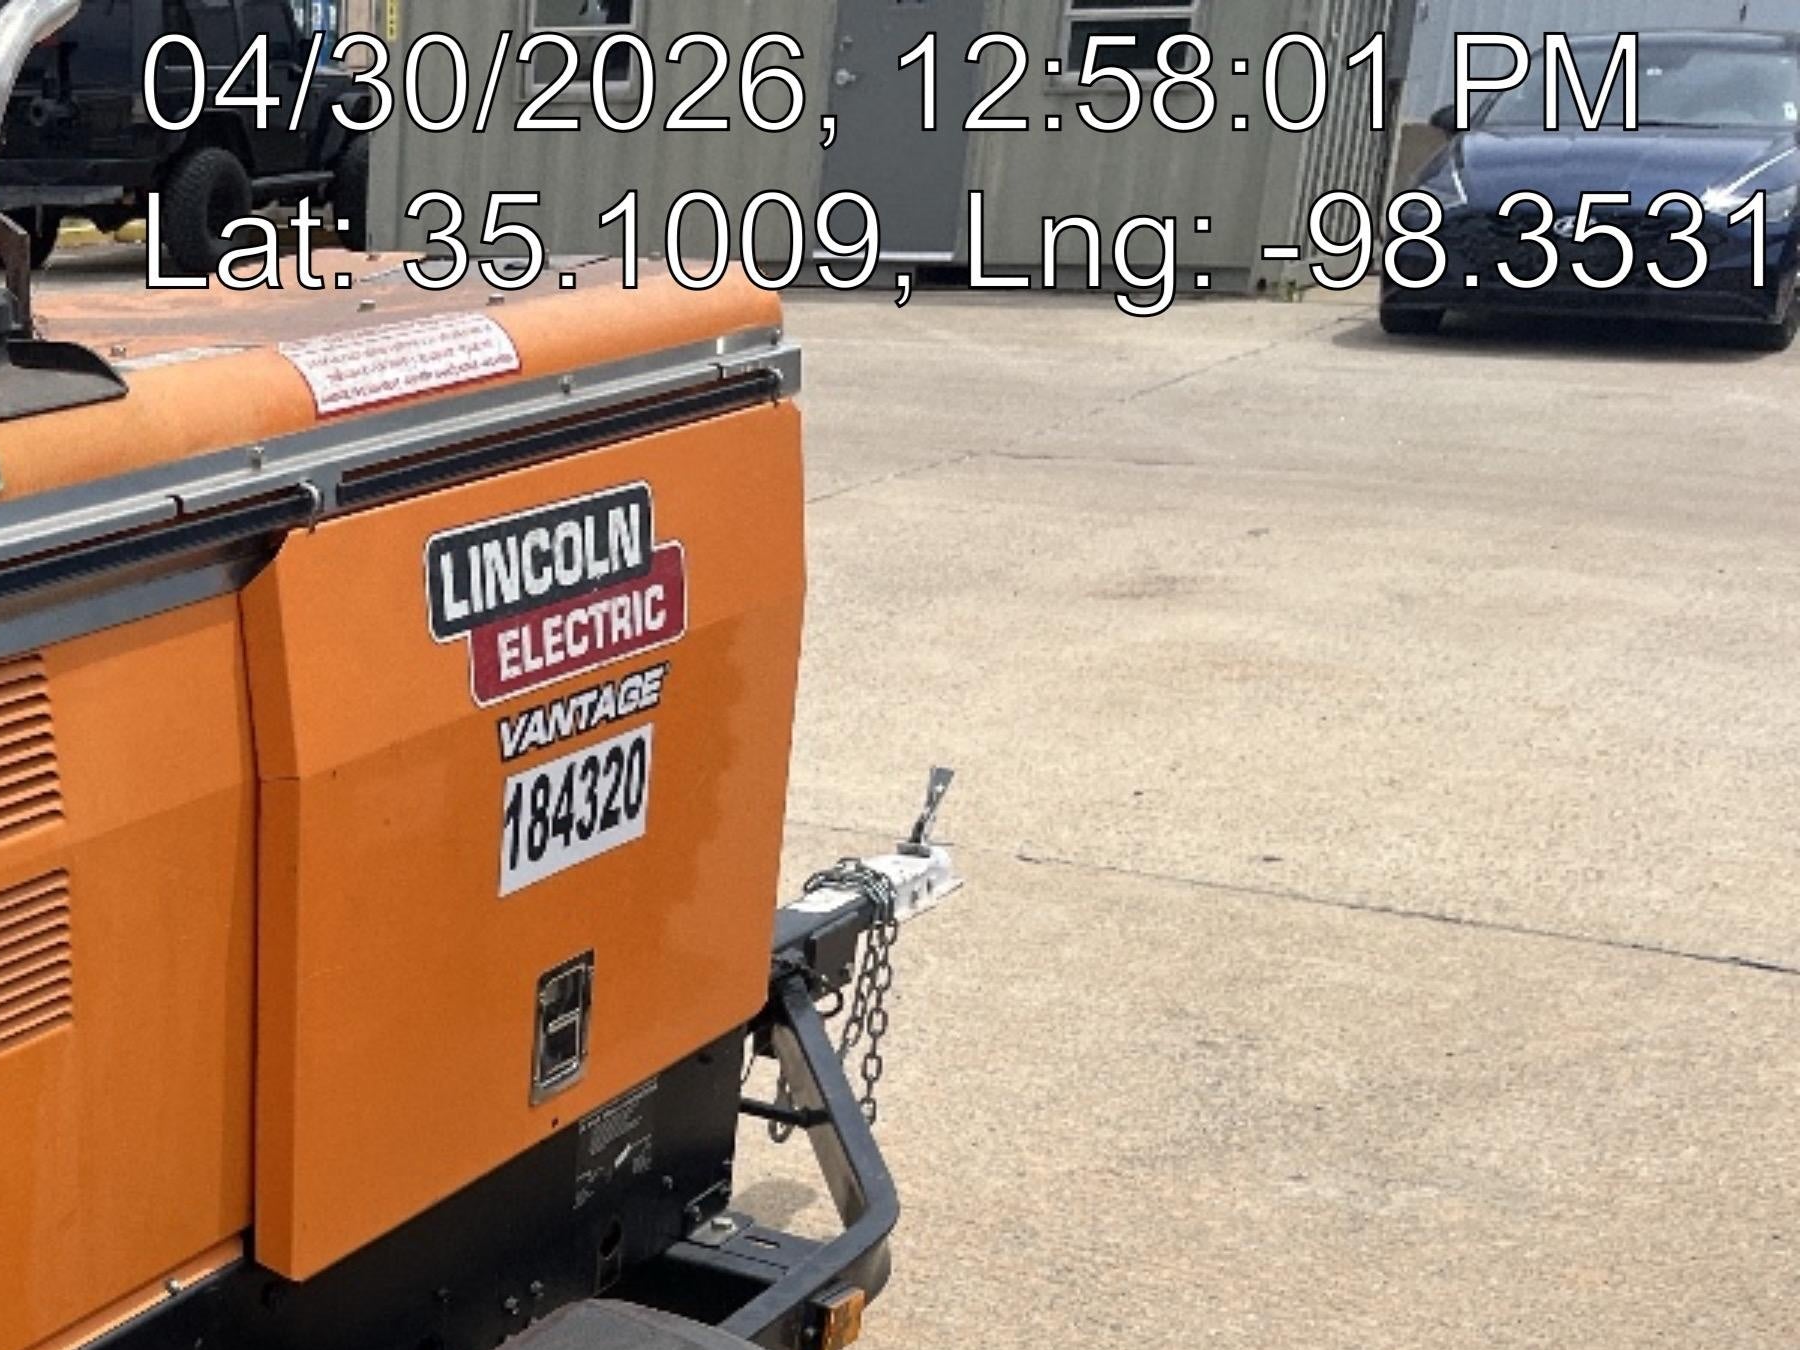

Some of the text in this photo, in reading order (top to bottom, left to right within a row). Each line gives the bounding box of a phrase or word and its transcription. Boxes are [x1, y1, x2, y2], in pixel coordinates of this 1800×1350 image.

[439, 503, 641, 622] LINCOLN
[497, 583, 667, 683] ELECTRIC
[498, 664, 667, 760] VANTAGE
[503, 735, 647, 871] 184320
